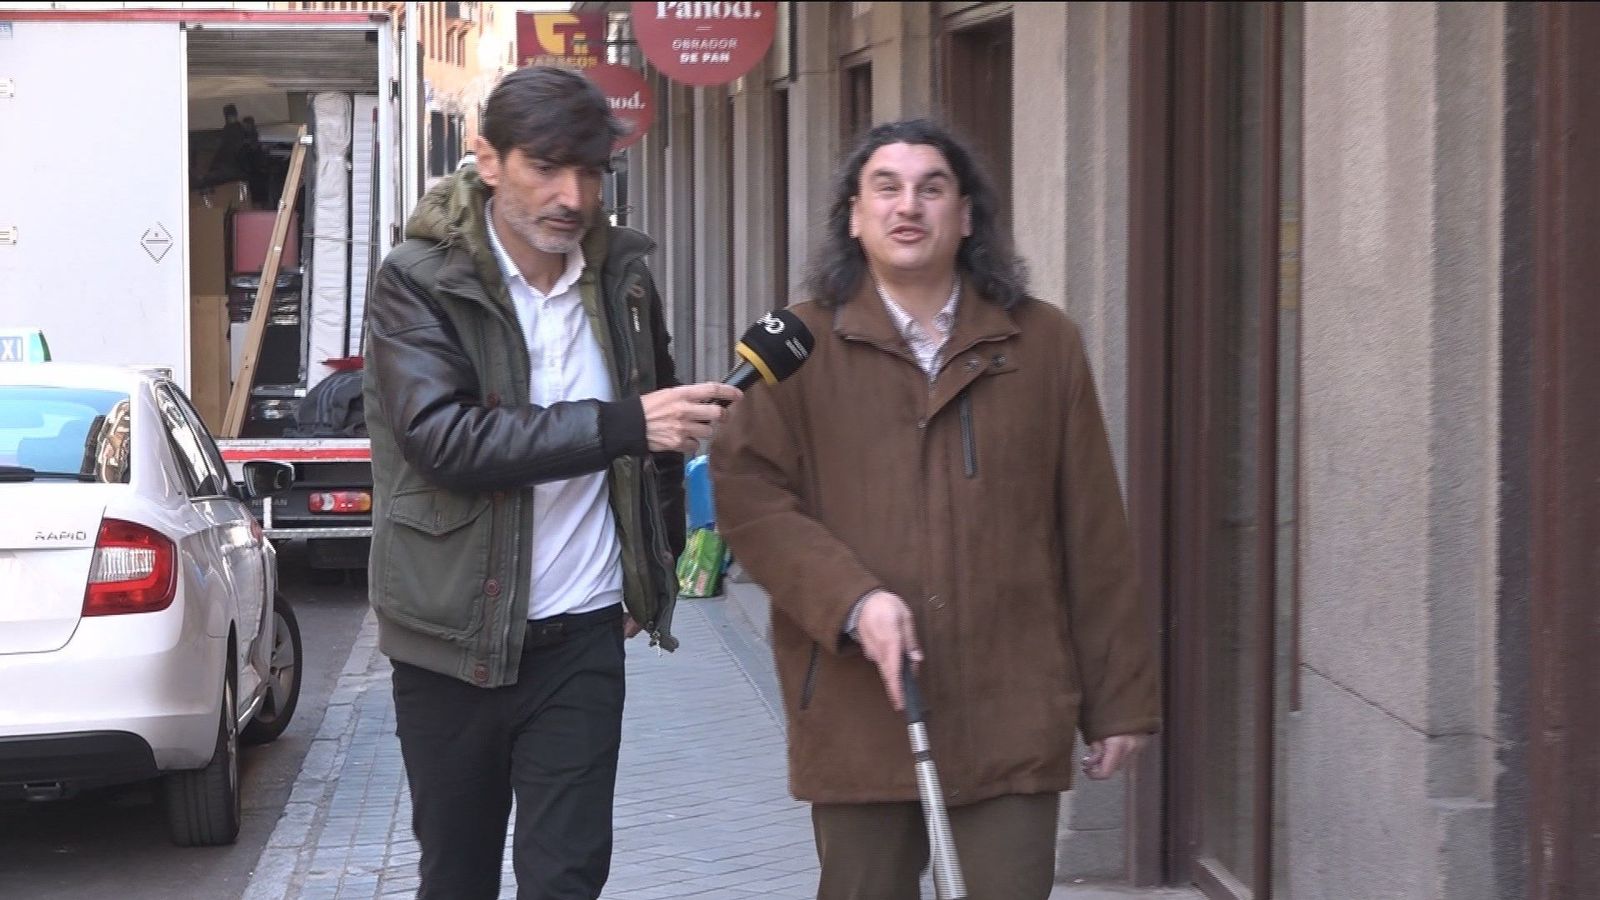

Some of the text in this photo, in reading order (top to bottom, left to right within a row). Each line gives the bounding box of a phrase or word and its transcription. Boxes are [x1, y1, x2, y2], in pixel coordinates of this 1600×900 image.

[672, 38, 737, 50] OBRADOR
[680, 52, 731, 63] DE PAN
[35, 530, 87, 541] RAPID
